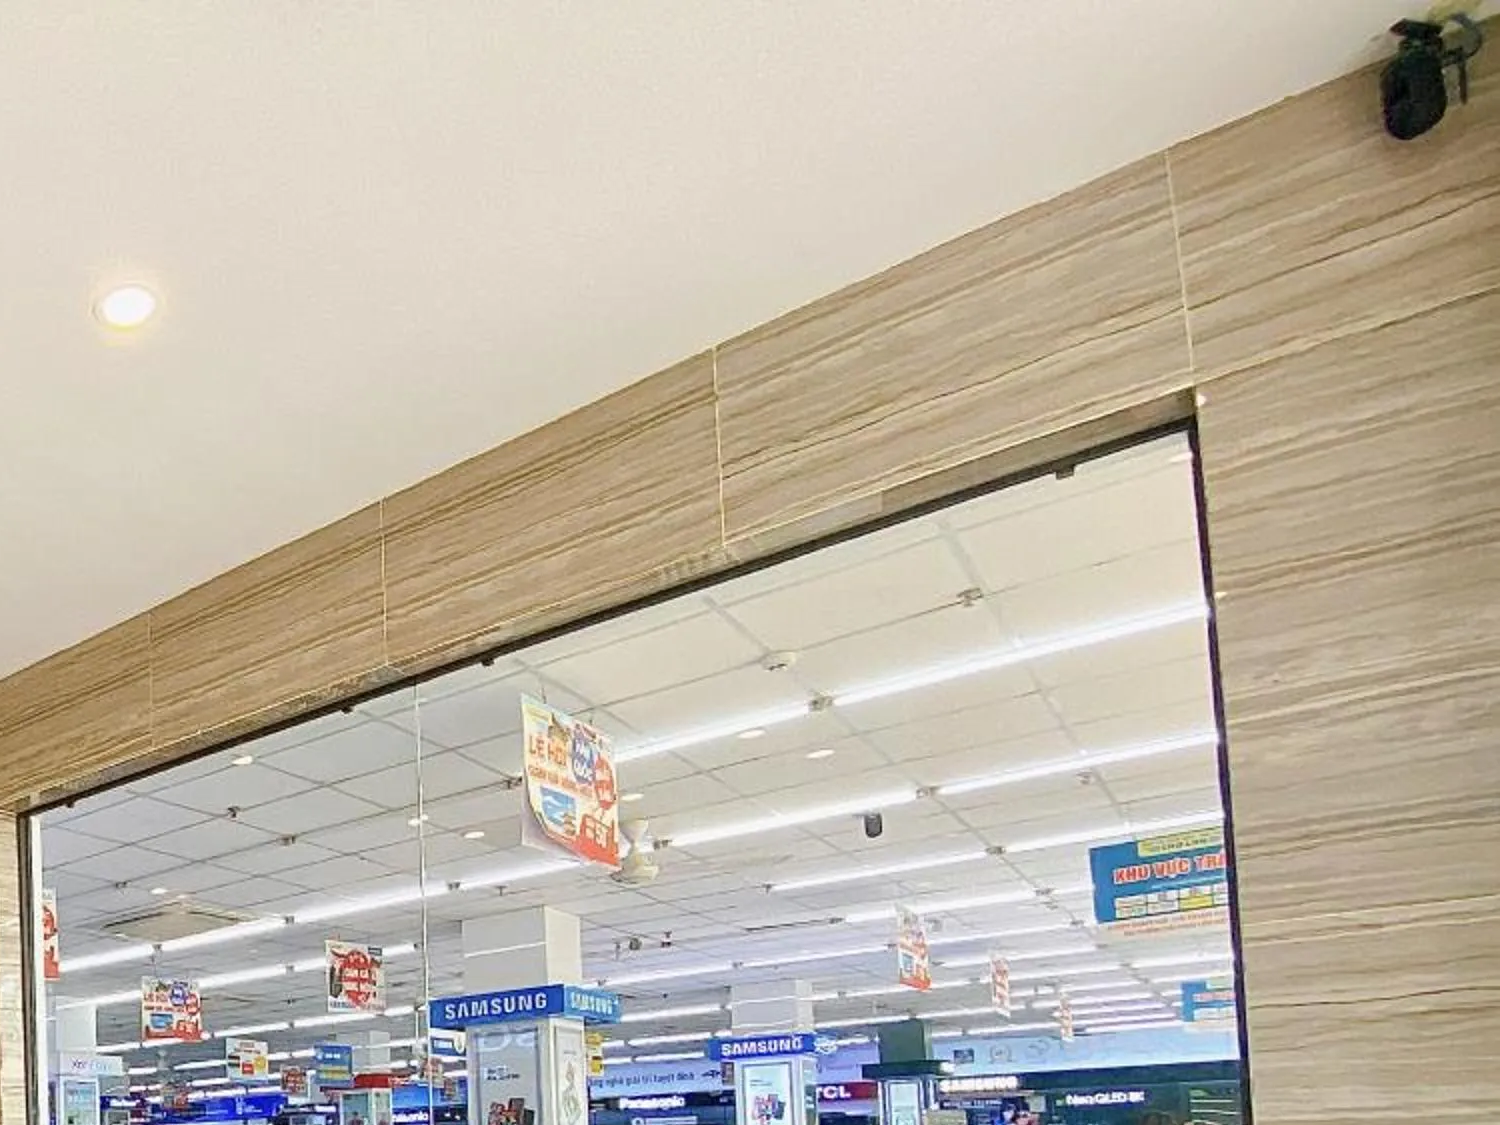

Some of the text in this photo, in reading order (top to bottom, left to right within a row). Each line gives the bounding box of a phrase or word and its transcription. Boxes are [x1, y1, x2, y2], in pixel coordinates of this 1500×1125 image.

[1114, 865, 1151, 884] KHU
[444, 992, 548, 1021] SAMSUNG
[721, 1036, 803, 1057] SAMSUNG
[816, 1084, 852, 1100] TCL
